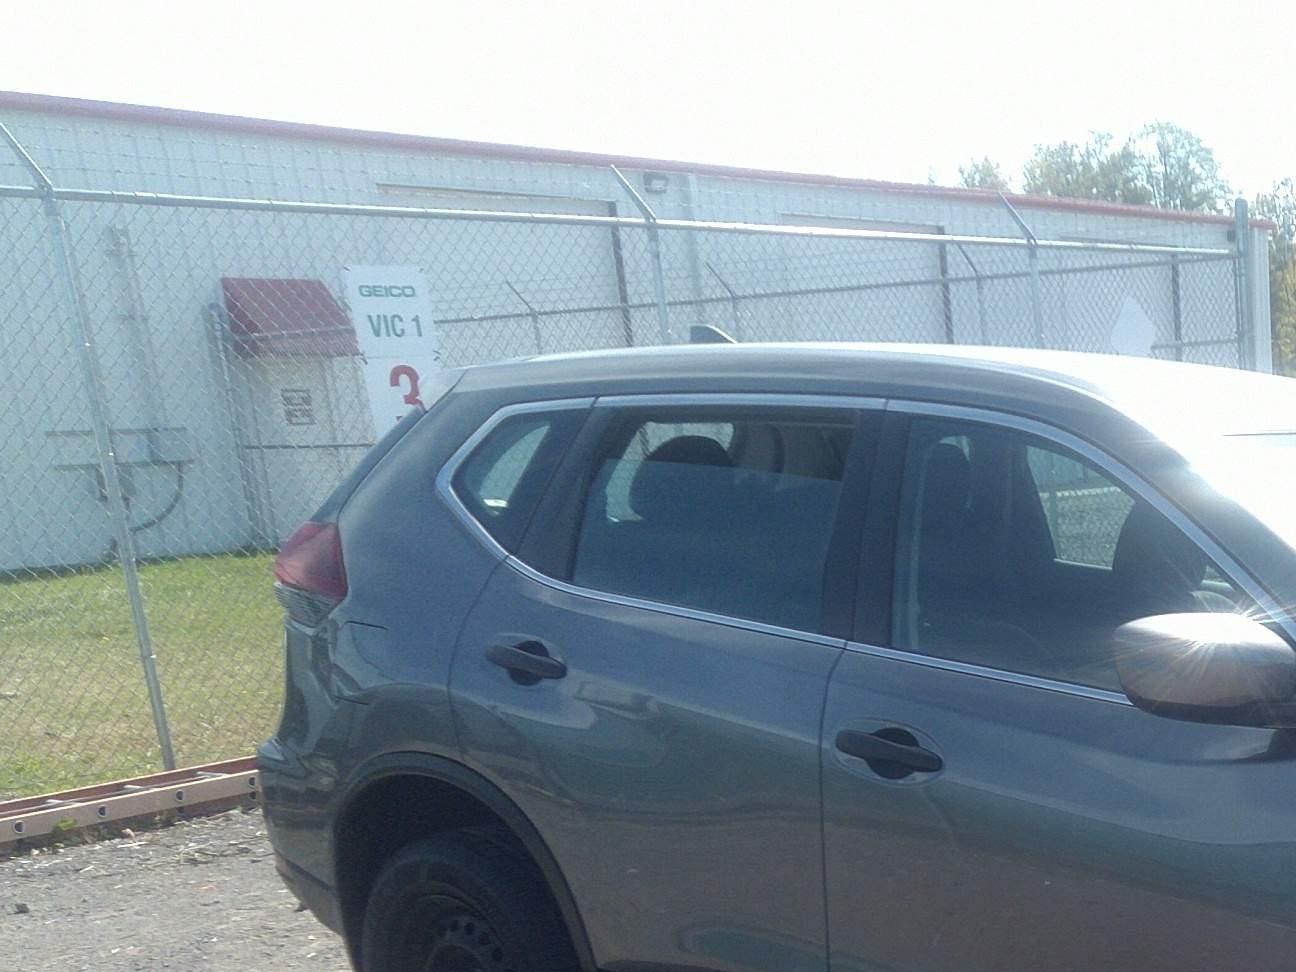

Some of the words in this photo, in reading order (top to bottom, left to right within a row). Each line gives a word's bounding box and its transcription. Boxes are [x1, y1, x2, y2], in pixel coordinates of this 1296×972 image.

[358, 285, 415, 298] GEICO
[367, 314, 405, 338] VIC
[411, 314, 422, 337] 1
